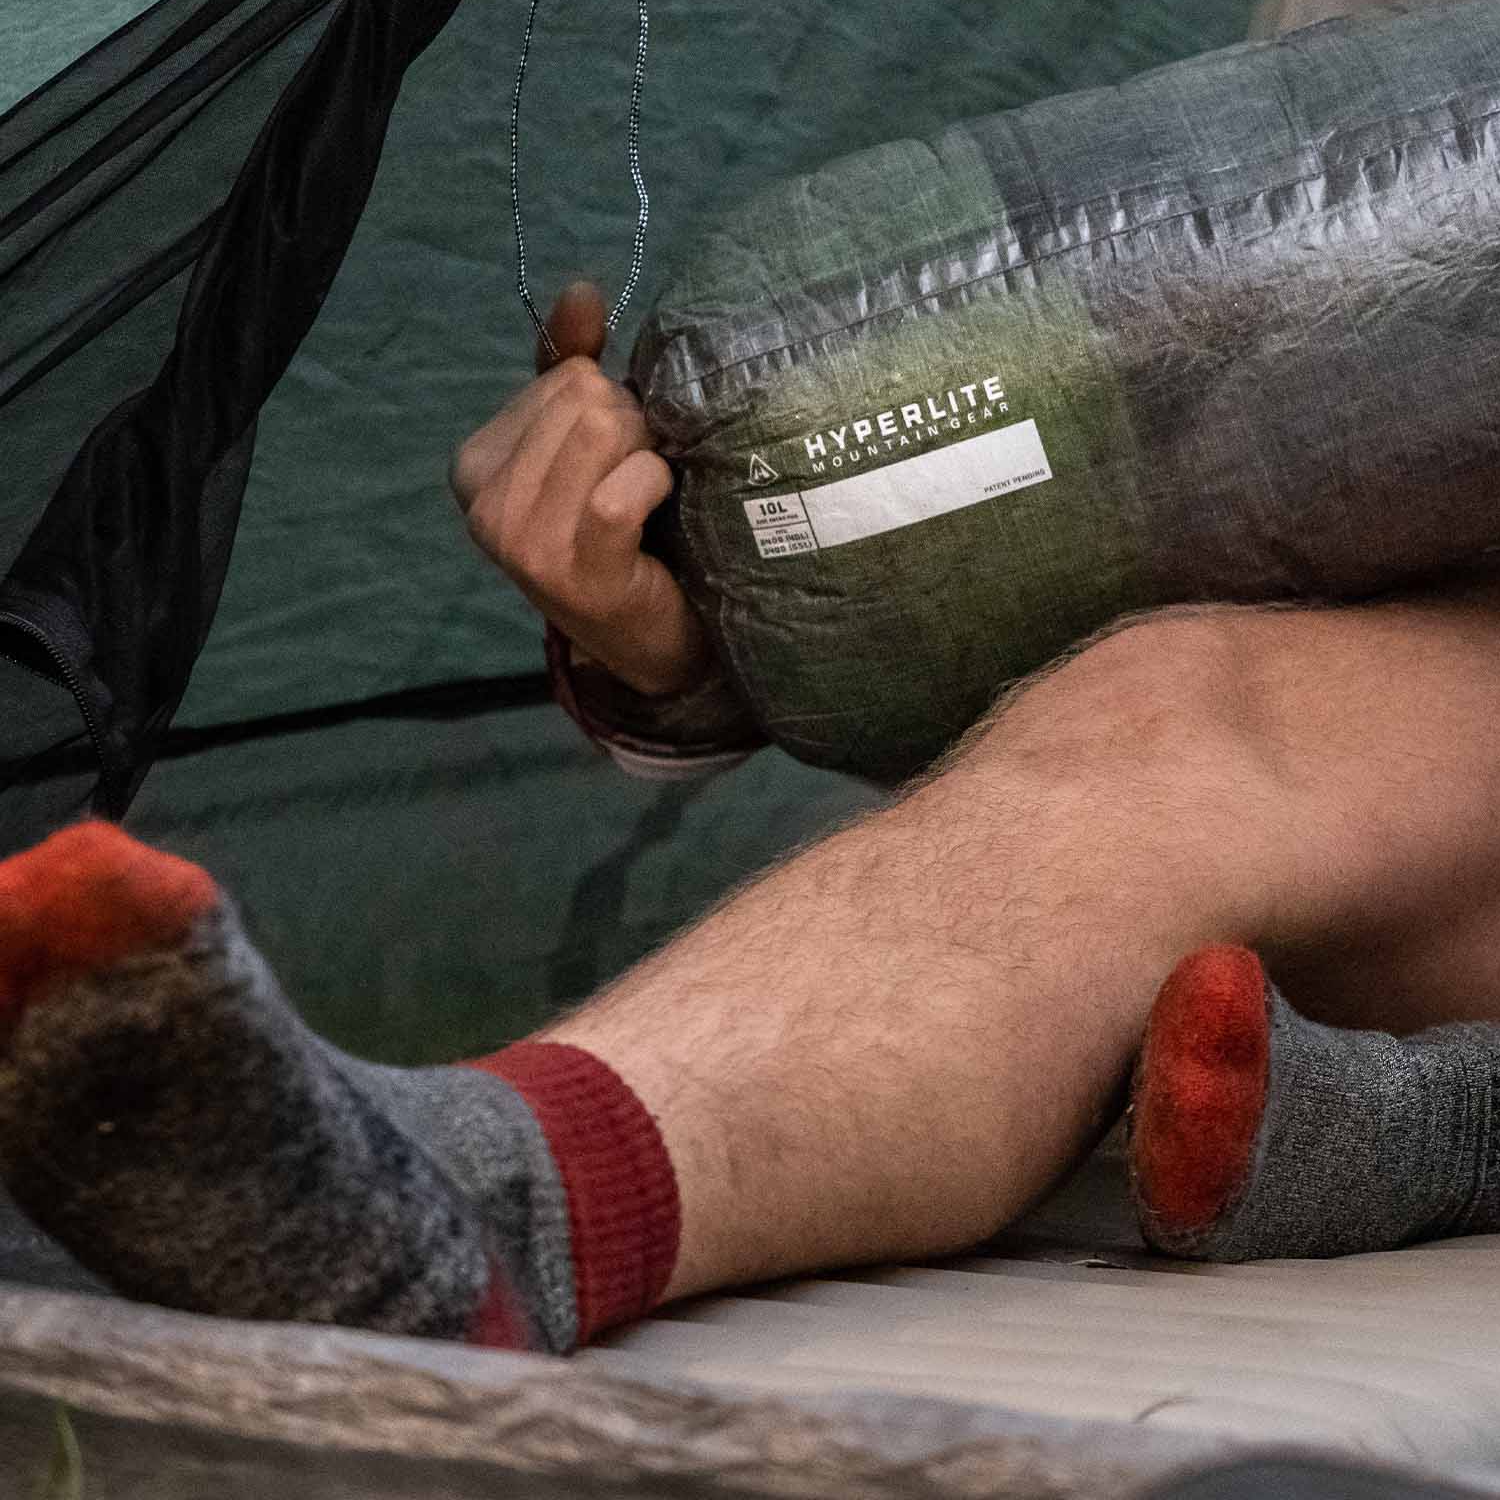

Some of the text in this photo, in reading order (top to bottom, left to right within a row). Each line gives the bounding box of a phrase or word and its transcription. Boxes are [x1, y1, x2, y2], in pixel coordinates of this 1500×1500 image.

[804, 376, 1004, 459] HYPERLITE
[812, 402, 1009, 473] MOUNTAIN GEAR
[984, 468, 1045, 493] PATENT PENDING
[759, 501, 788, 516] 10L
